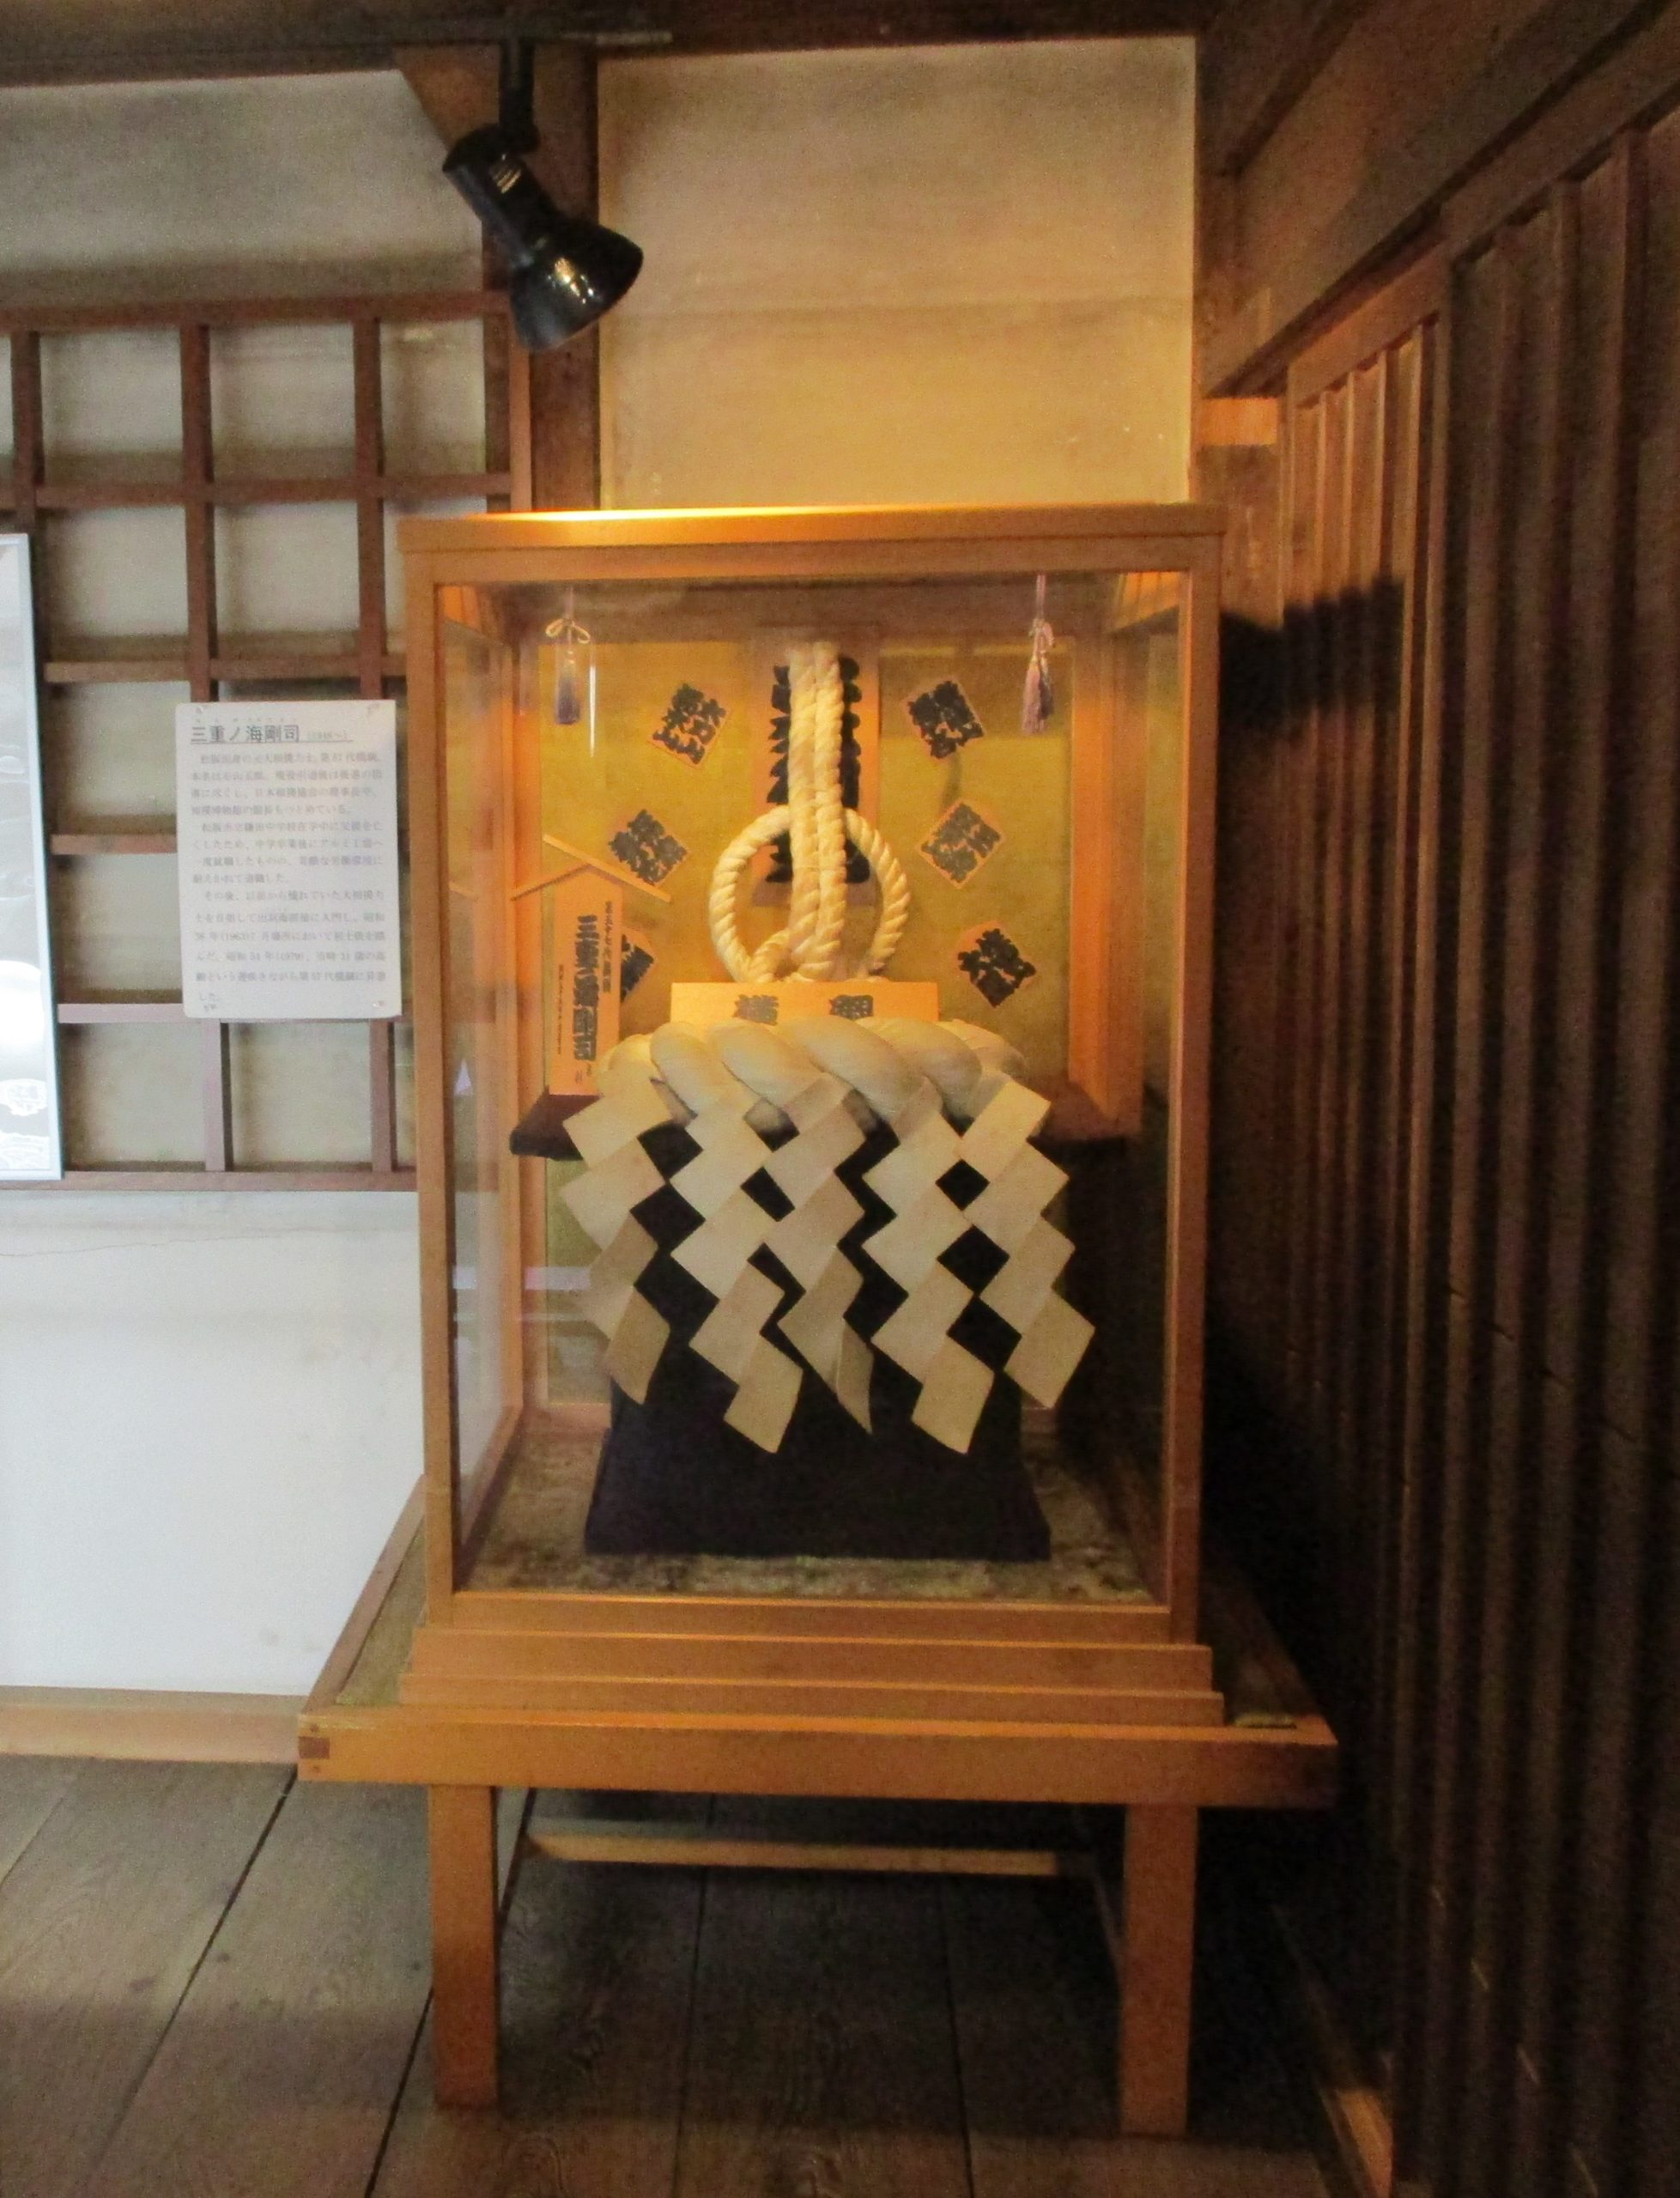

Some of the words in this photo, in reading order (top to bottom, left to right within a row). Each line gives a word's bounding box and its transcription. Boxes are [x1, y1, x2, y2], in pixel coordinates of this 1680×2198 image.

[191, 725, 300, 742] 三重ノ海剛司
